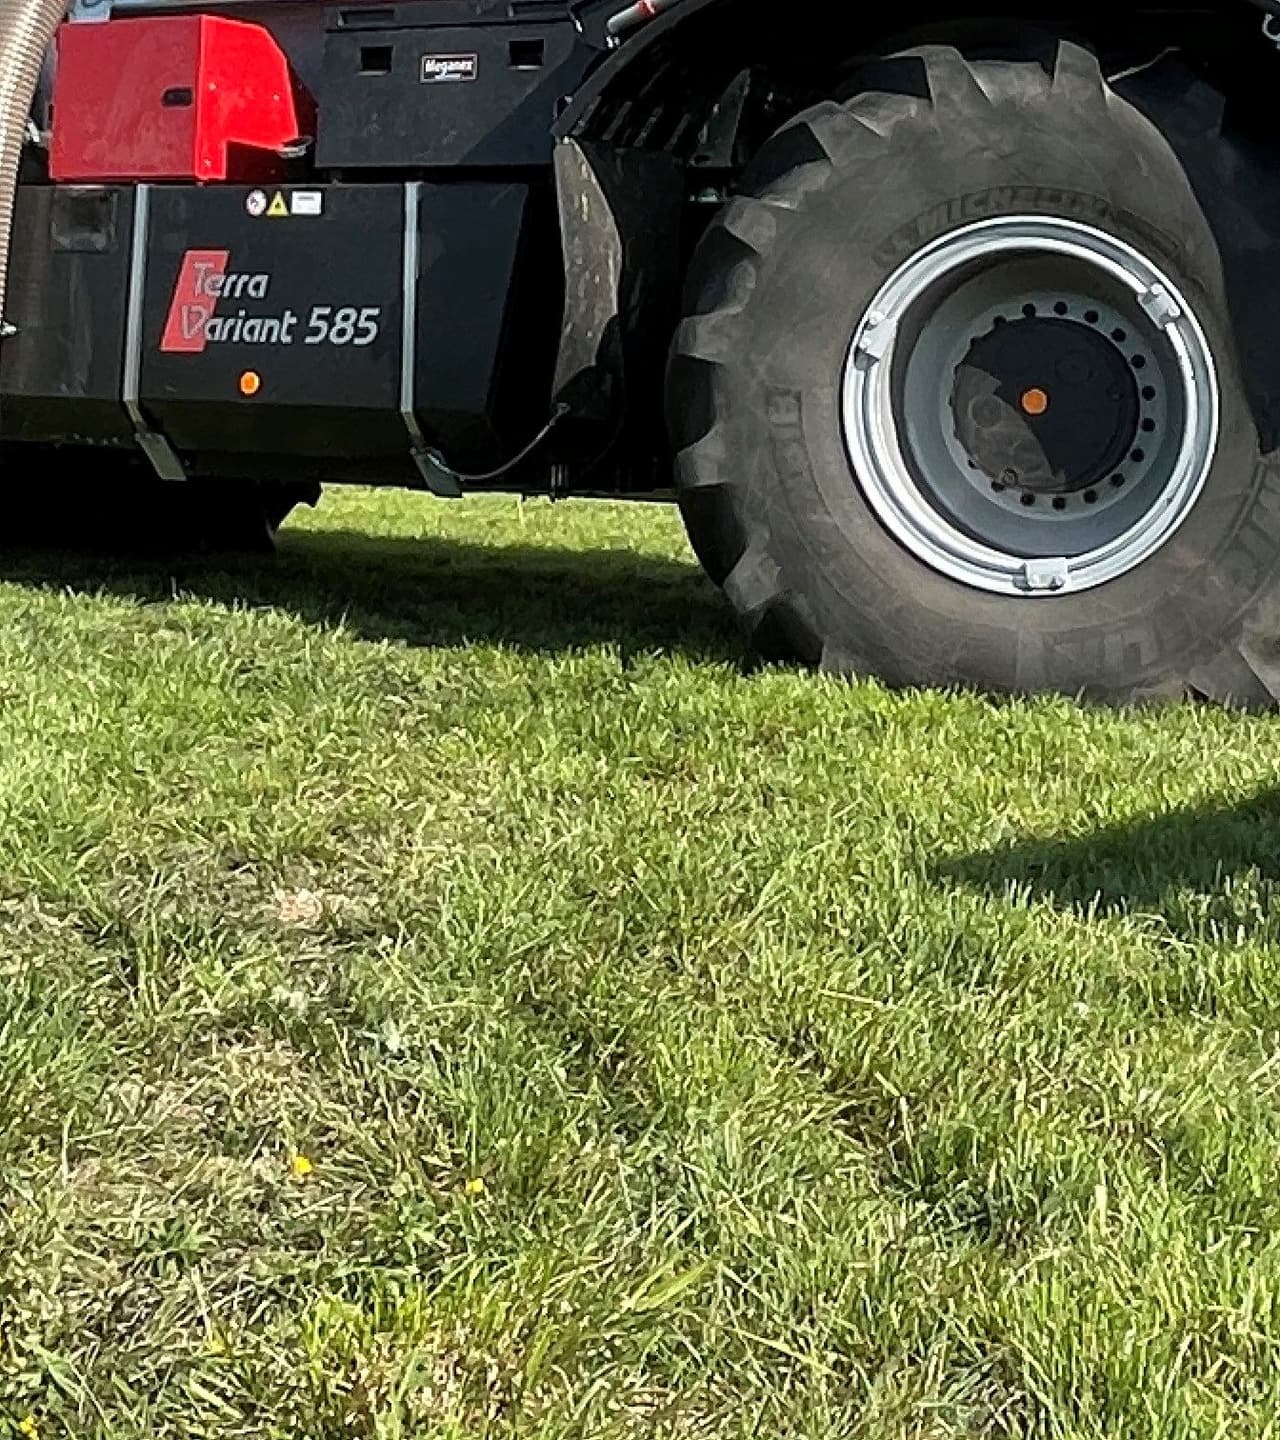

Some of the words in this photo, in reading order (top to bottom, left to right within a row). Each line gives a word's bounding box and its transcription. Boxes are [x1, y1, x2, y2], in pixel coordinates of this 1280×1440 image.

[193, 262, 269, 298] Terra
[181, 305, 297, 343] Variant
[304, 306, 381, 345] 585
